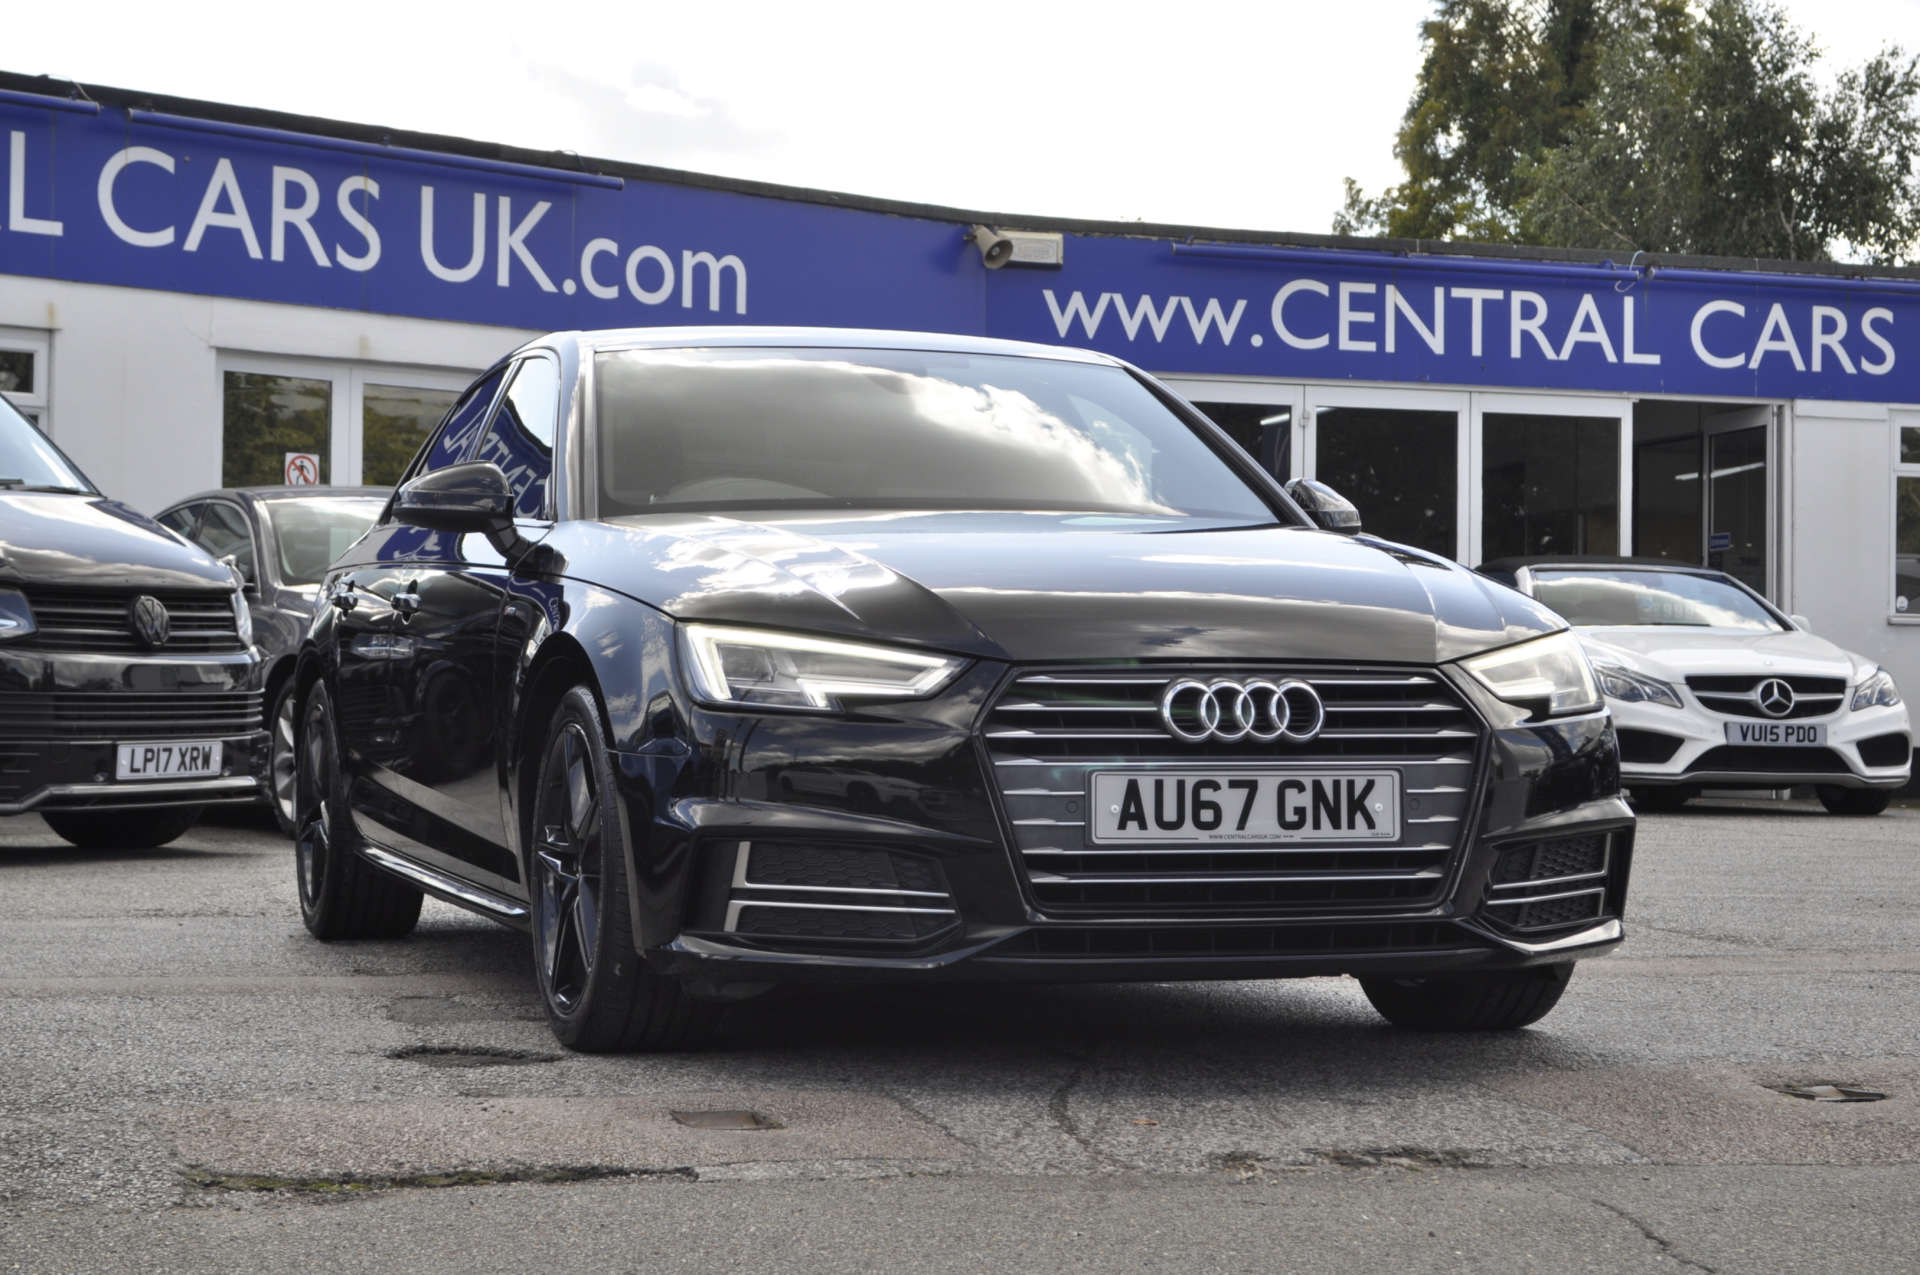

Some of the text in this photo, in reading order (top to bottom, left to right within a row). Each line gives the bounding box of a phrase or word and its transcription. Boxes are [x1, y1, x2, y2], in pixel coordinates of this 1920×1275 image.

[0, 130, 747, 315] L CARS UK.com
[1043, 278, 1896, 376] www.CENTRAL CARS
[129, 746, 213, 774] LP17 XRW
[1740, 723, 1818, 744] VU15 PDO
[1116, 778, 1376, 832] AU67 GNK
